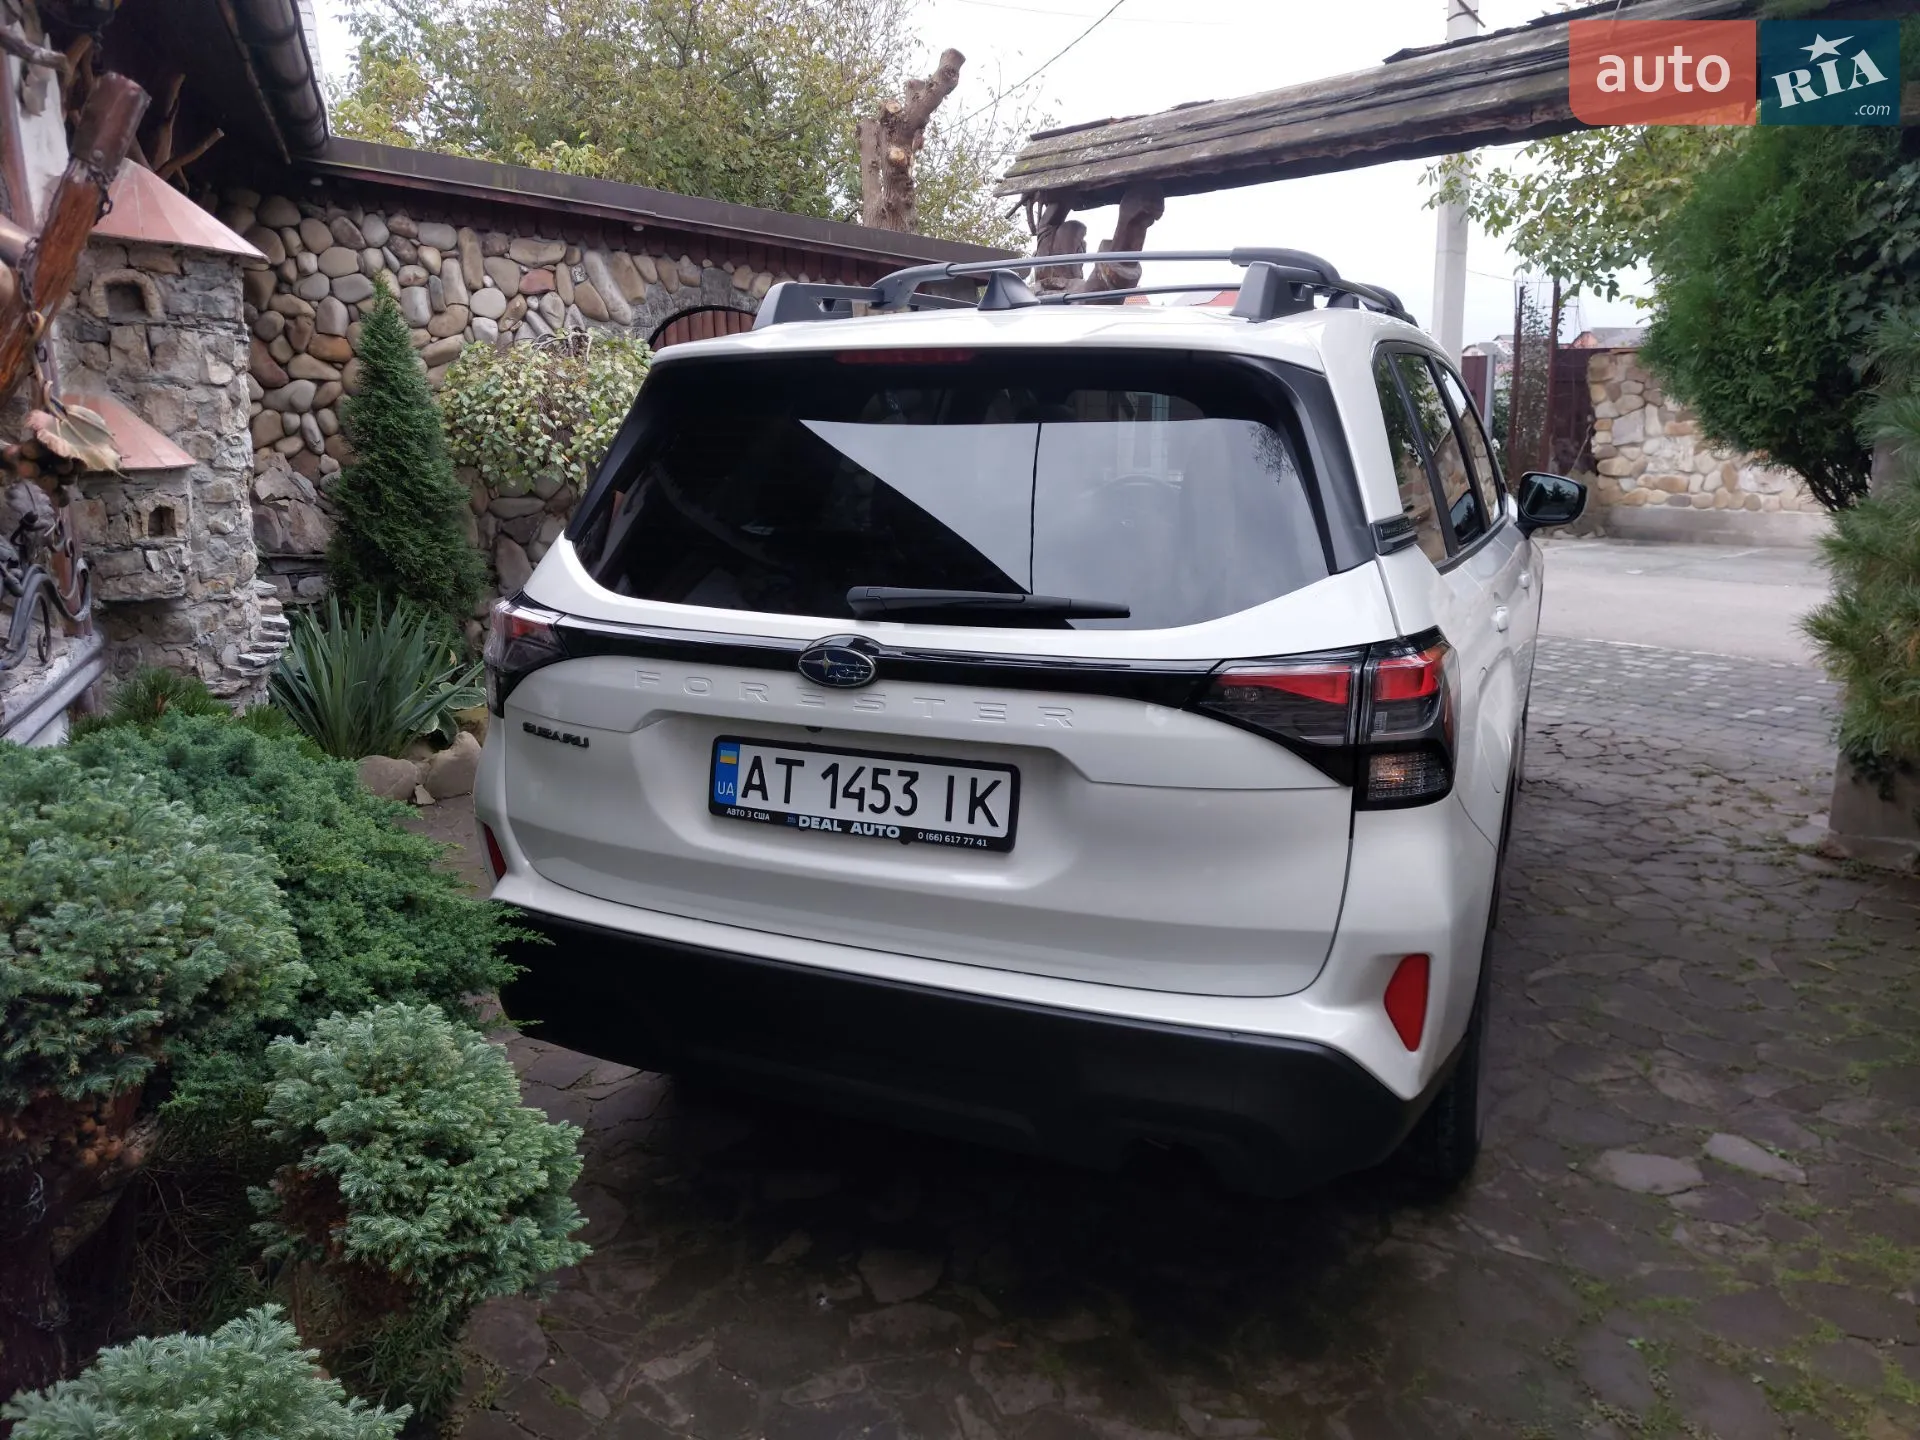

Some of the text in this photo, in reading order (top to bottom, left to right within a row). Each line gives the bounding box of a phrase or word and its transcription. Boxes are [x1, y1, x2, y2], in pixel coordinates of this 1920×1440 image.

[633, 669, 1075, 729] FORESTER
[522, 721, 590, 749] SUBARU
[717, 780, 735, 797] UA
[741, 755, 1003, 828] AT 1453 IK
[726, 807, 745, 817] АВТО
[753, 811, 770, 821] США
[798, 815, 843, 832] DEAL
[850, 821, 901, 839] AUTO
[917, 831, 988, 847] 0 (66) 617 77 41
